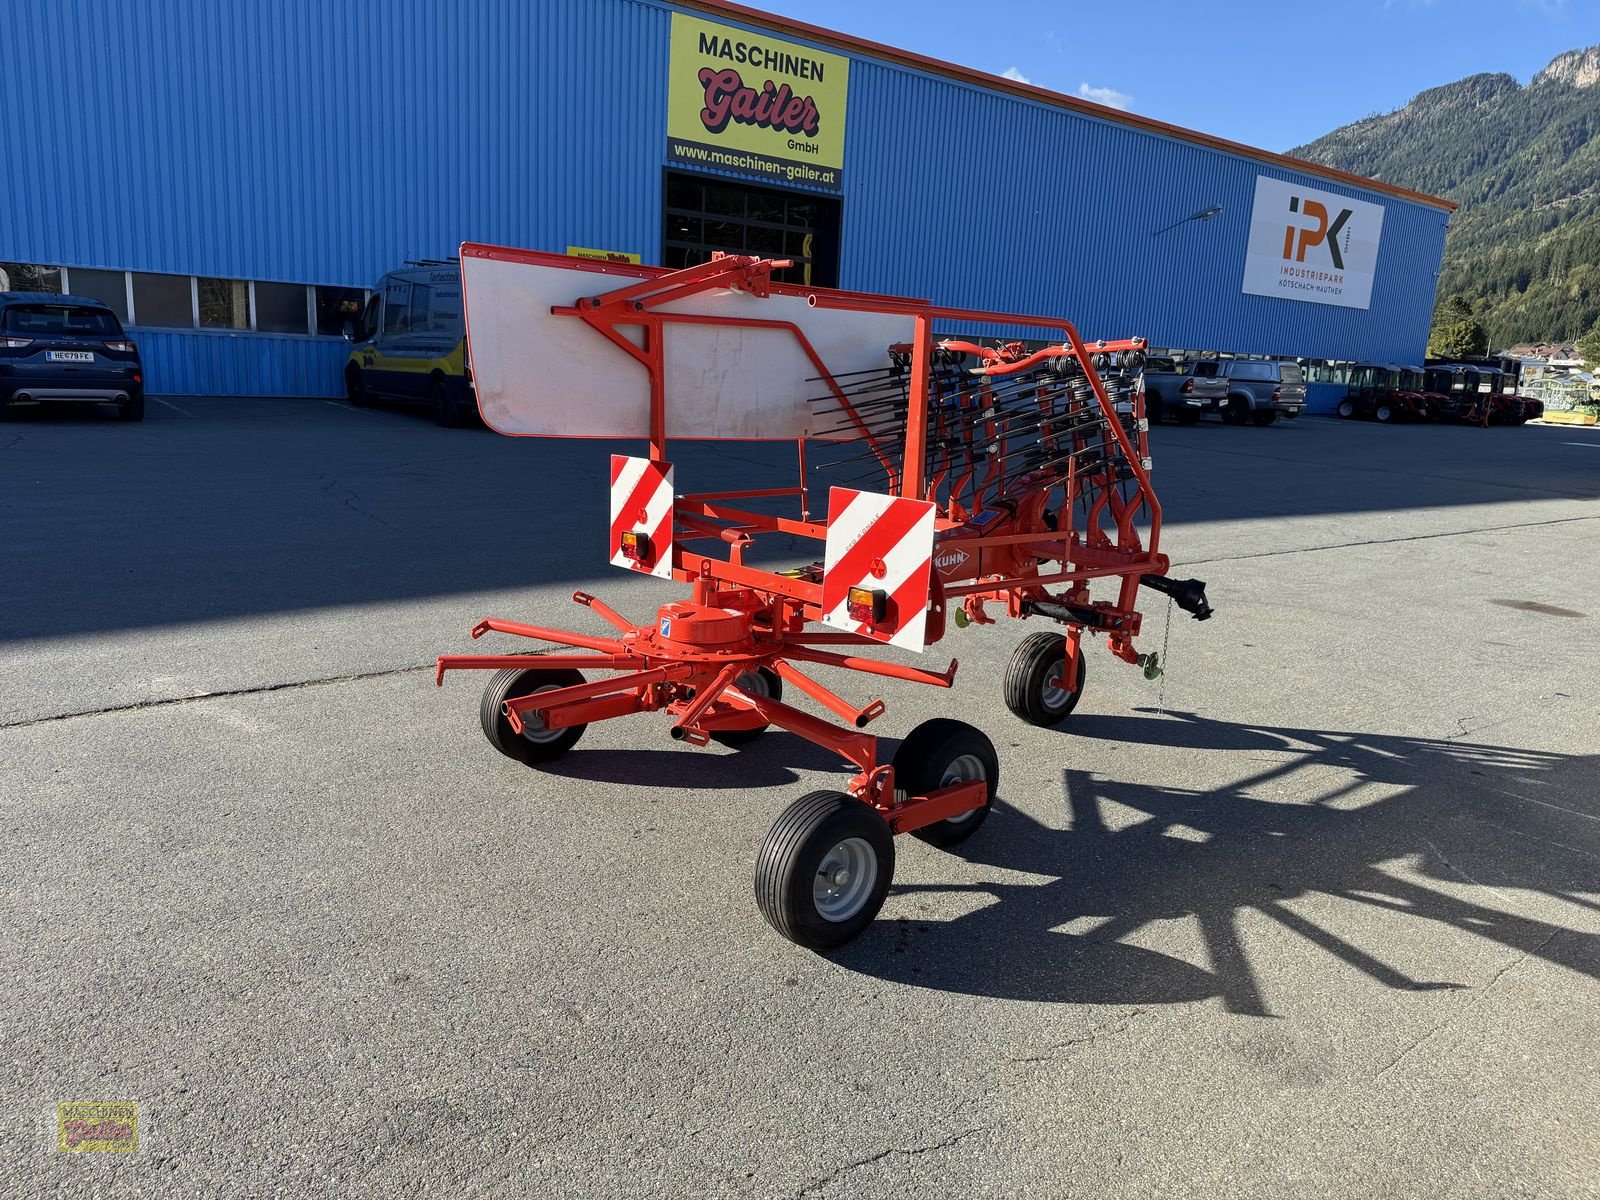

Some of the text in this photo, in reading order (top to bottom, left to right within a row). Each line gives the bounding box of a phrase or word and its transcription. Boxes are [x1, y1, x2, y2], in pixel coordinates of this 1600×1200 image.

[699, 32, 824, 82] MASCHINEN
[698, 67, 820, 137] Gailer
[787, 139, 819, 154] GmbH
[674, 144, 835, 183] www.maschinen-gailer.at
[1280, 265, 1344, 284] INDUSTRIEPARK
[934, 551, 965, 568] KUHN
